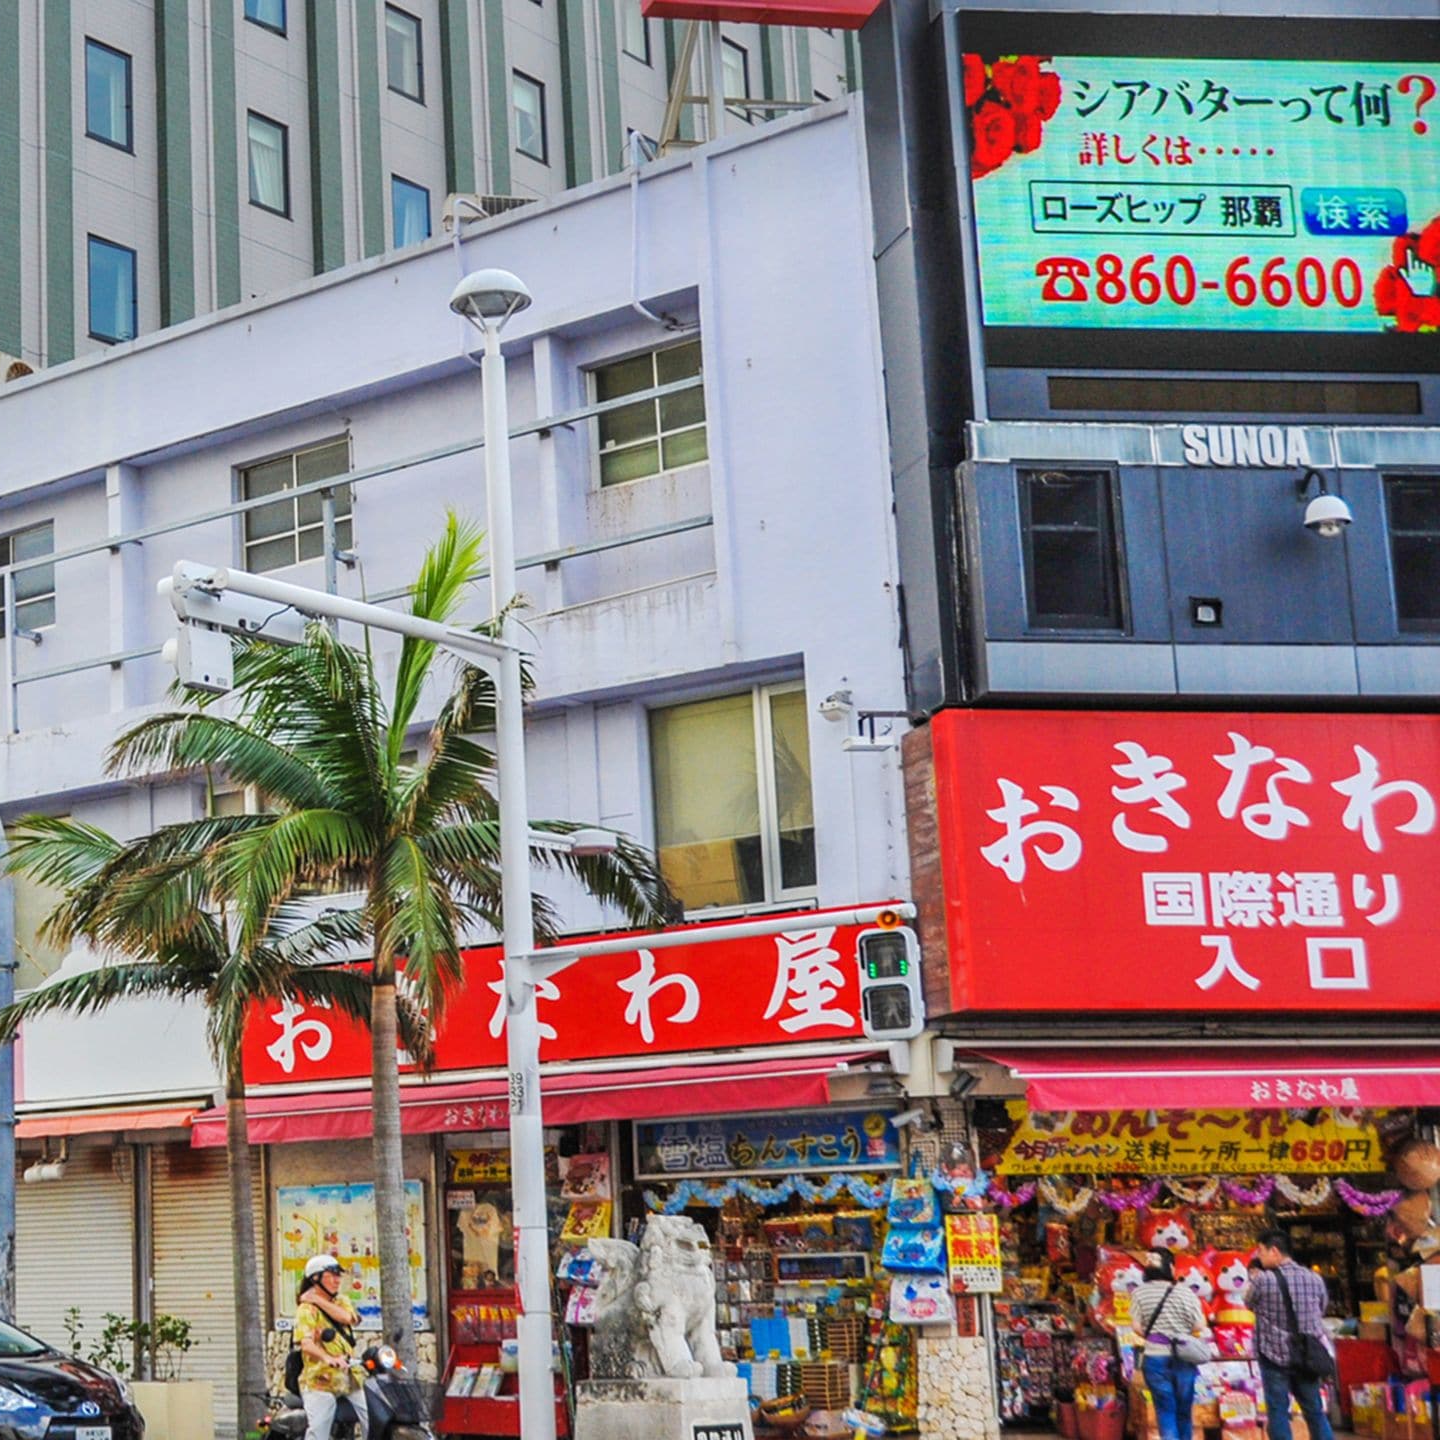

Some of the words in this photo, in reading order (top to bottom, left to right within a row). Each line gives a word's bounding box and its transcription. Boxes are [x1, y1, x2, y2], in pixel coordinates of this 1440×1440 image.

[1042, 194, 1206, 226] ローズヒップ
[1221, 194, 1283, 228] 那覇
[1315, 195, 1391, 231] 検索
[1095, 253, 1364, 308] 860-6600
[1182, 425, 1311, 467] SUNOA
[979, 732, 1437, 883] おきなわ
[1142, 871, 1401, 928] 国際通り
[1195, 935, 1370, 991] 入口
[266, 928, 855, 1073] おなわ屋
[1250, 1078, 1361, 1102] おきなわ屋
[444, 1104, 506, 1127] おきなわ
[657, 1126, 861, 1172] 雪塩ちんすこう
